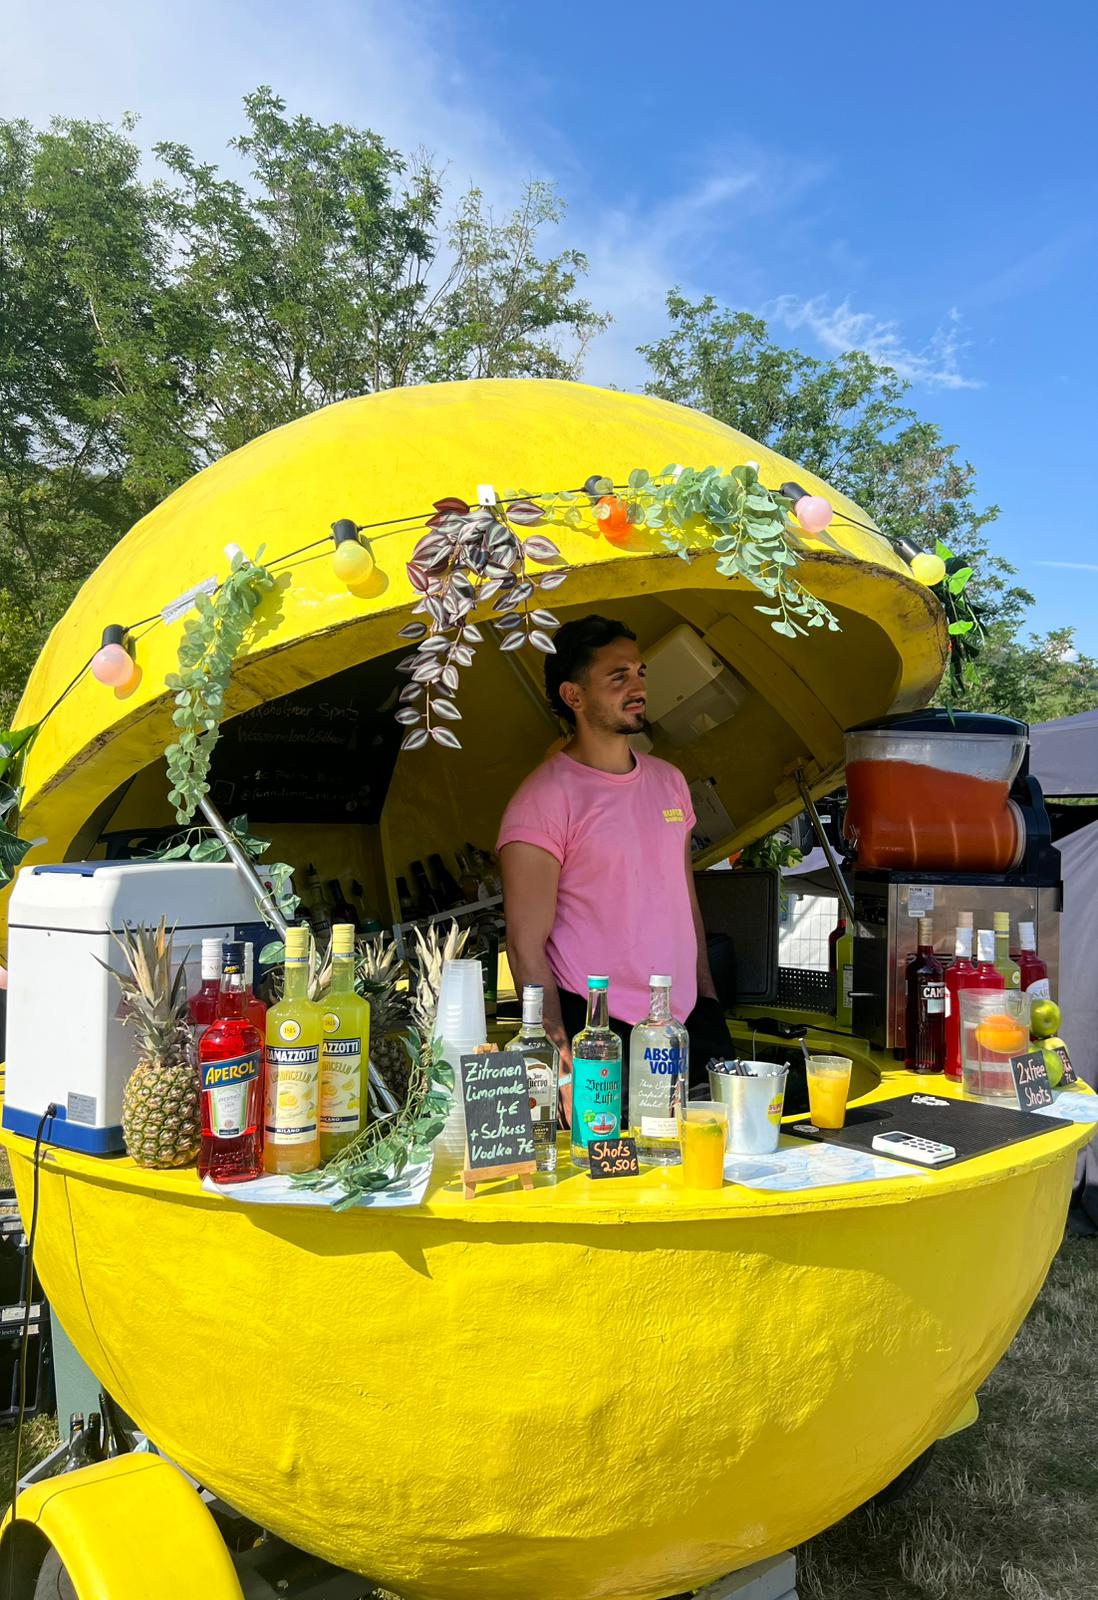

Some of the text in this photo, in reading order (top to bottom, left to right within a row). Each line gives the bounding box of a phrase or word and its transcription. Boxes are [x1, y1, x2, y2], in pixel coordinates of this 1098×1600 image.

[266, 1048, 318, 1063] RAMAZZOTTI
[205, 1059, 256, 1087] APEROL
[464, 1059, 522, 1083] Zitronen
[593, 1091, 613, 1105] Luft
[1024, 1086, 1051, 1107] Shots
[496, 1100, 519, 1119] 4€
[481, 1119, 526, 1143] Schuss
[471, 1138, 535, 1162] Vodka 7€
[591, 1141, 631, 1160] Shots
[600, 1157, 638, 1174] 2,50€
